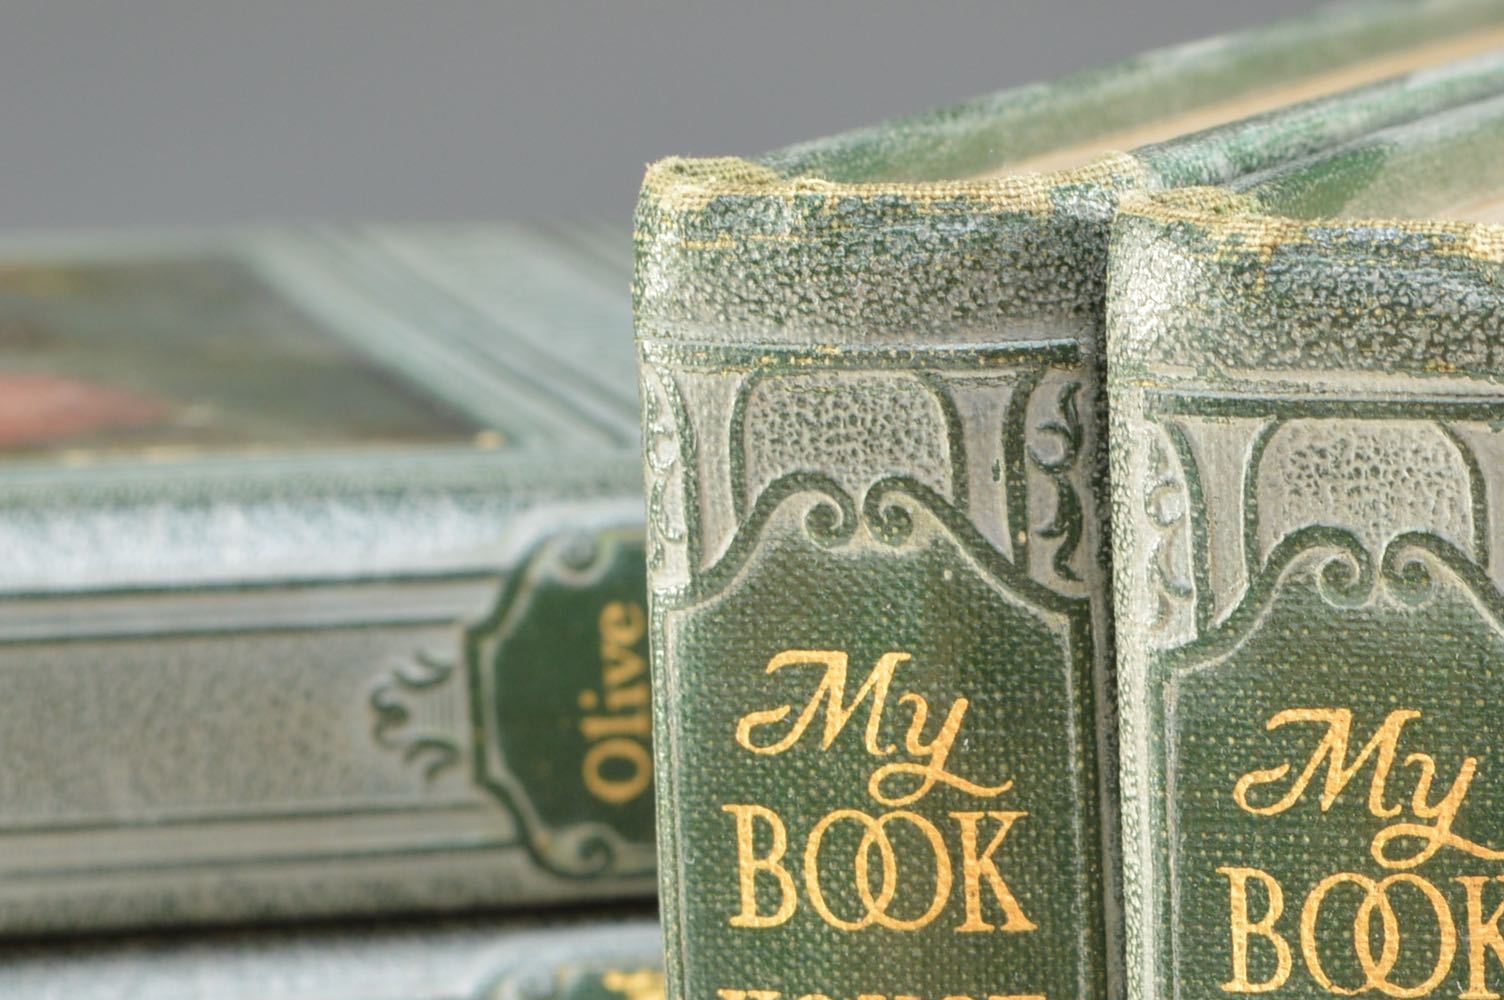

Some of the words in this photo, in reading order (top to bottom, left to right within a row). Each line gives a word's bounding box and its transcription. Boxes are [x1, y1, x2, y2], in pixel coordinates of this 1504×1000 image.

[578, 600, 654, 804] Olive
[735, 648, 1013, 804] My
[721, 806, 1038, 933] BOOK
